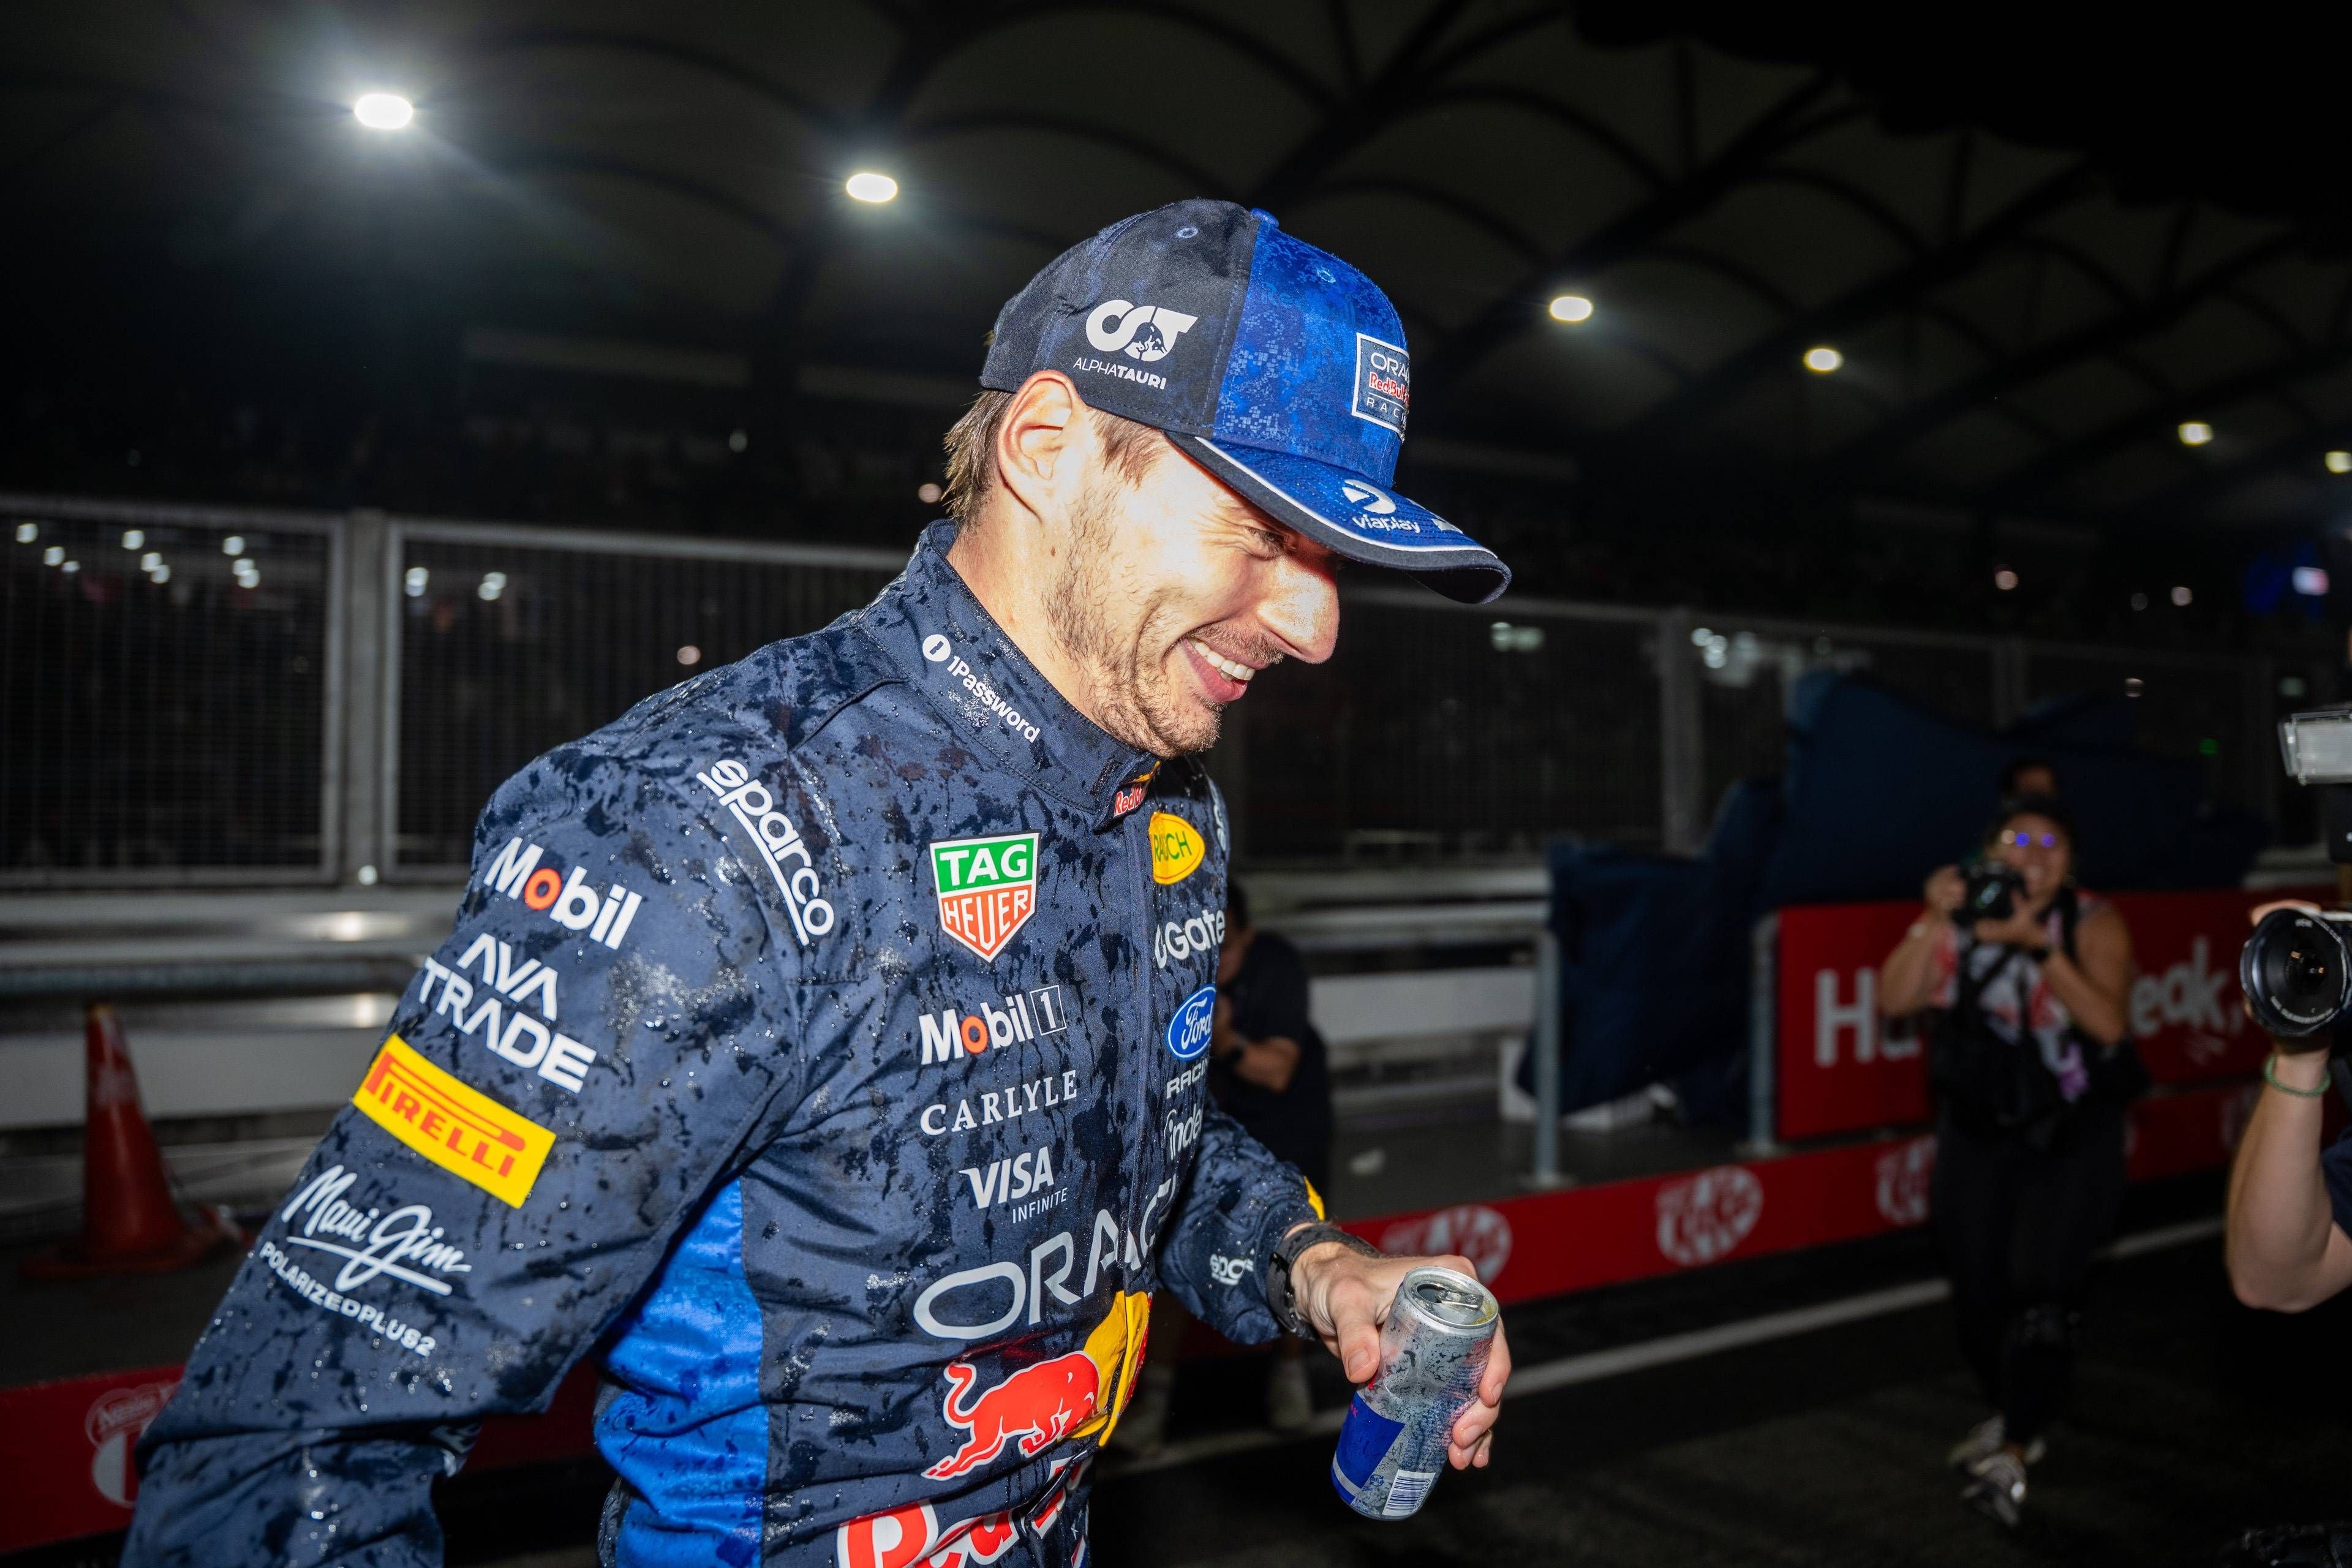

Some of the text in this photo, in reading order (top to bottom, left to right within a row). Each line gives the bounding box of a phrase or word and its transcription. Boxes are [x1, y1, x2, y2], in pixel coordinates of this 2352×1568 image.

[1072, 357, 1167, 390] ALPHATAURI
[1352, 514, 1420, 533] viaplay
[947, 655, 1041, 743] 1Password
[710, 759, 834, 936] sparco
[939, 844, 1027, 886] TAG
[483, 836, 643, 950] Mobil
[943, 889, 1028, 951] HEUER
[456, 932, 558, 1022] AVA
[419, 956, 597, 1094] TRADE
[919, 993, 1035, 1065] Mobil
[1181, 997, 1214, 1050] Ford
[365, 1052, 526, 1178] PIRELLI
[920, 1069, 1077, 1136] CARLYLE
[959, 1146, 1055, 1209] VISA
[1012, 1187, 1068, 1224] INFINITE
[281, 1164, 472, 1292] Maui Jim
[260, 1241, 436, 1357] POLARIZEDPLUS2
